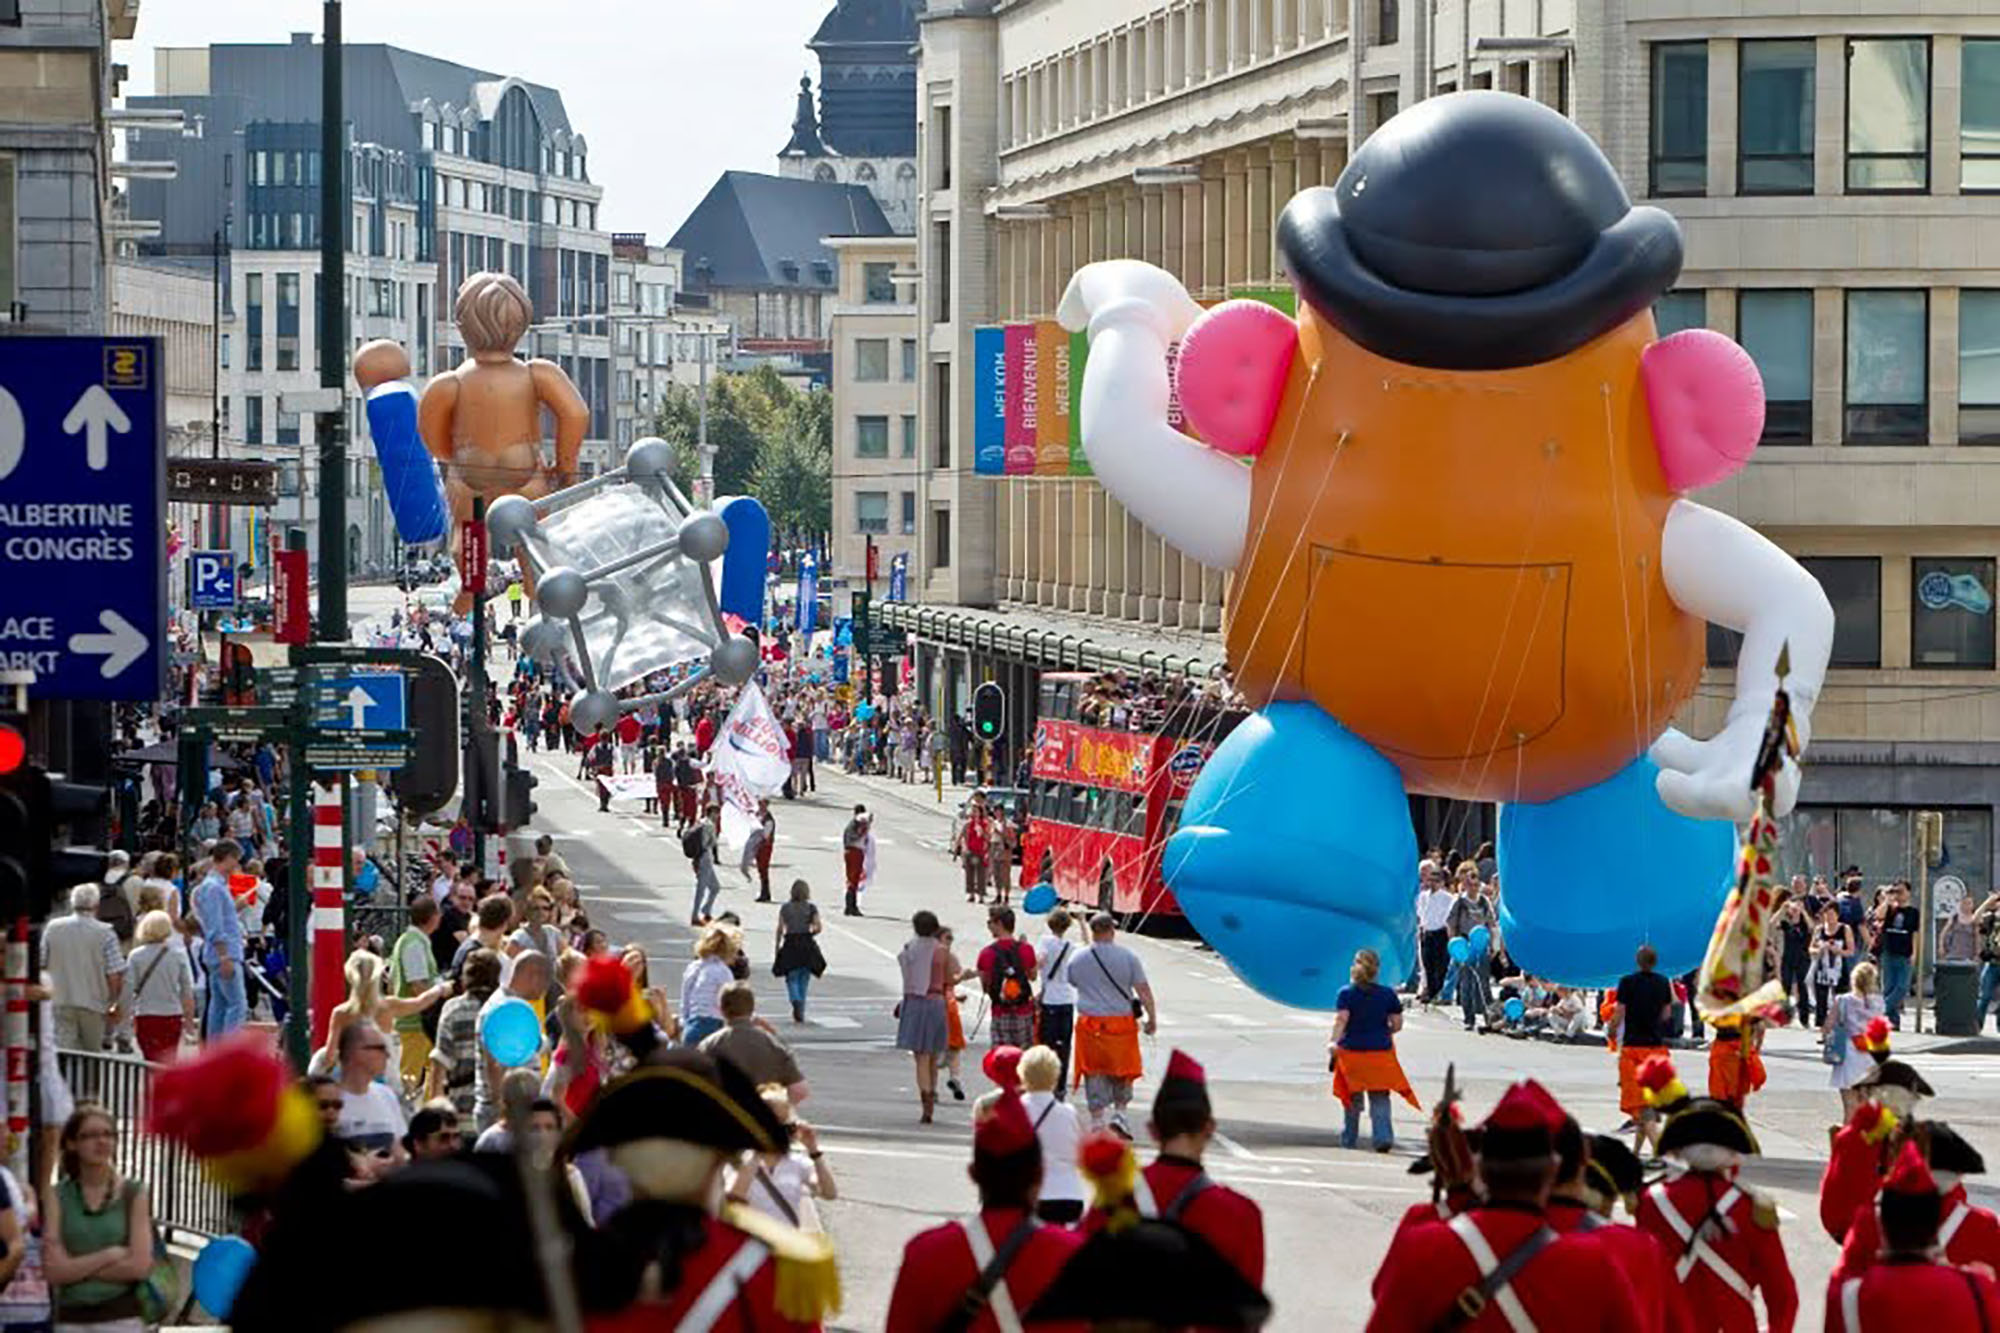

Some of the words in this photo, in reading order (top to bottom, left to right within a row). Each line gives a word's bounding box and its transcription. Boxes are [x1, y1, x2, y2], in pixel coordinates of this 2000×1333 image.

[994, 352, 1005, 418] WELKOM
[1022, 338, 1038, 429] BIENVENUE
[1055, 345, 1070, 416] WELKOM
[0, 504, 133, 526] ALBERTINE
[5, 529, 134, 561] CONGRÈS
[197, 558, 220, 592] P
[0, 617, 55, 640] ACE
